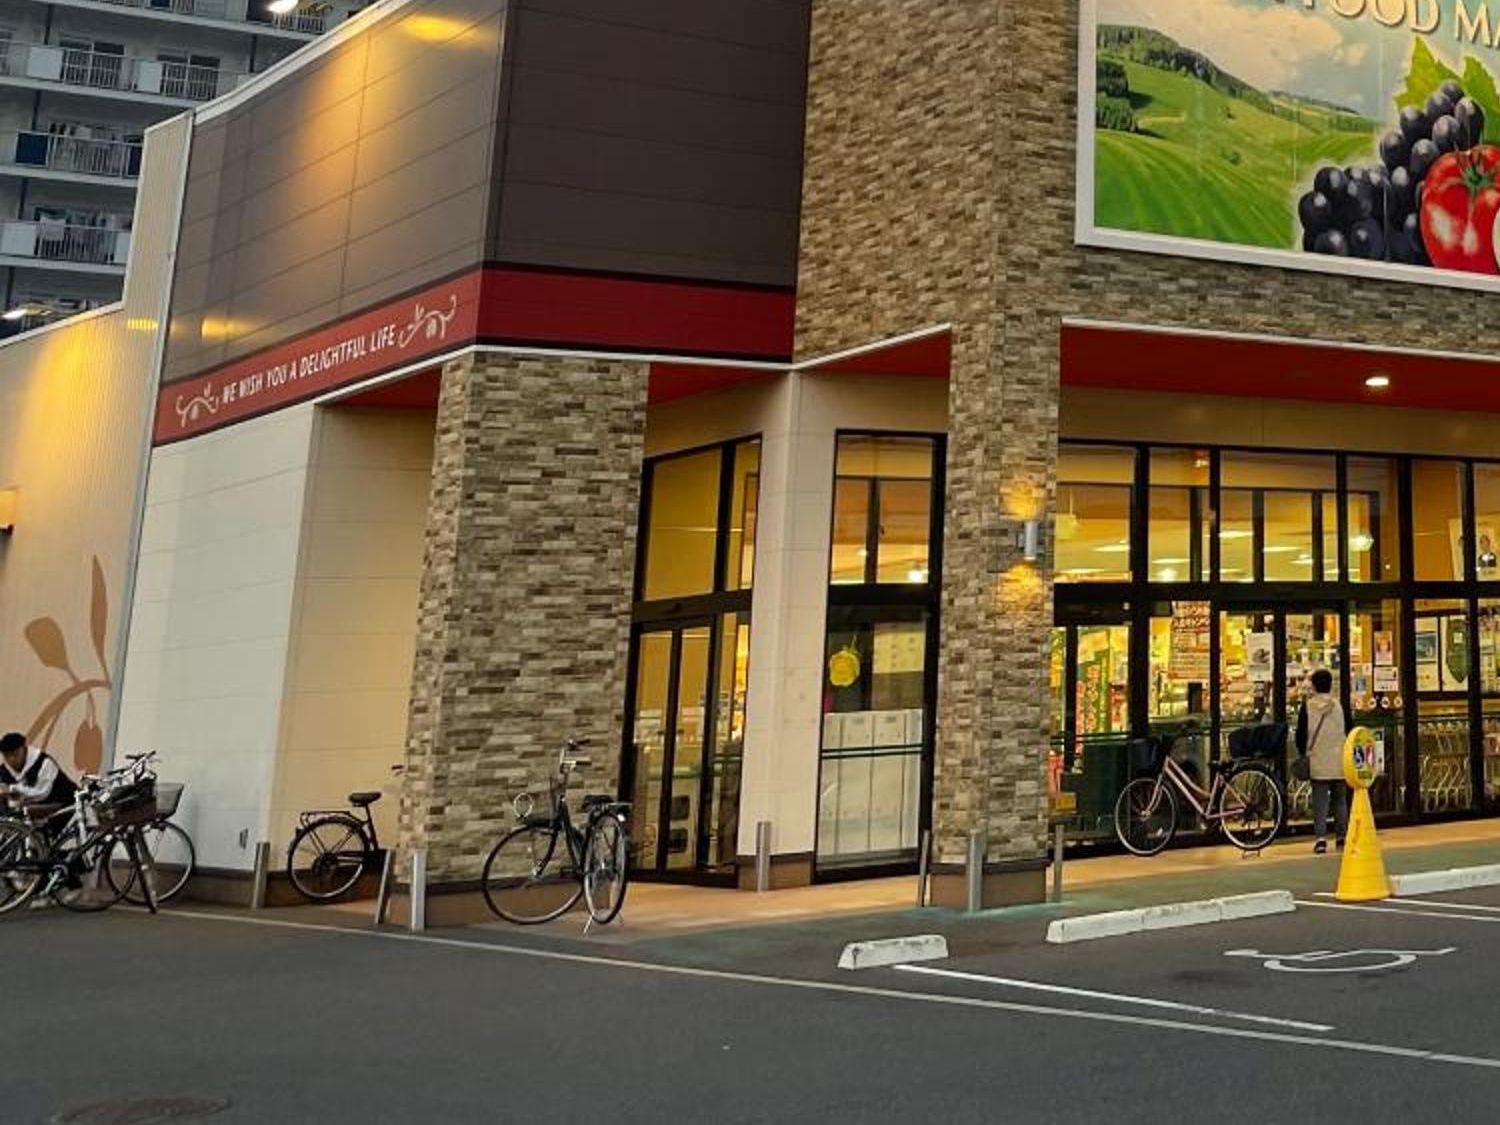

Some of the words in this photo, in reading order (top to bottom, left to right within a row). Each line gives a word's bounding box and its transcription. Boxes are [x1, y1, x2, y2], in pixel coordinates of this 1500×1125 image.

[221, 380, 237, 404] WE
[239, 373, 264, 397] WISH
[266, 364, 288, 387] YOU
[290, 362, 298, 381] A
[299, 335, 367, 378] DELIGHTFUL
[370, 324, 396, 352] LIFE
